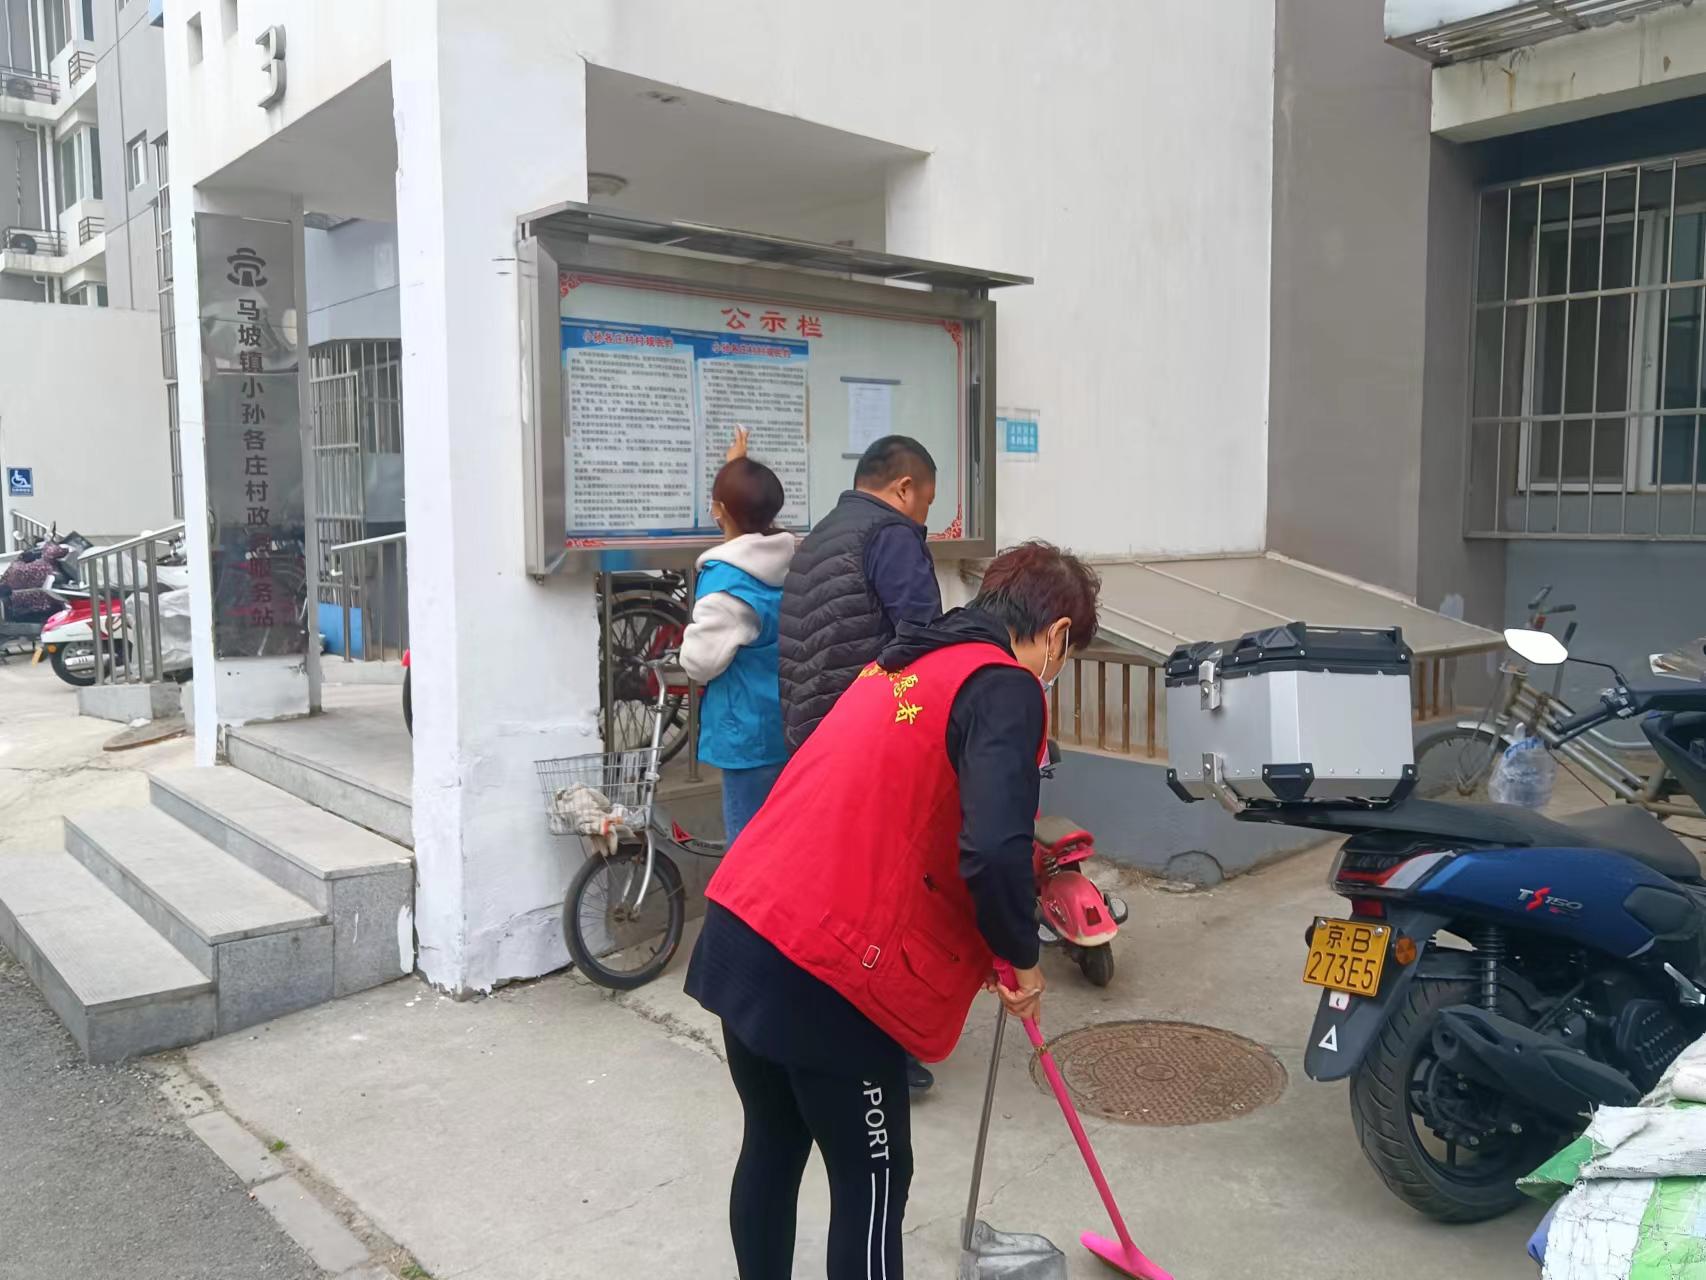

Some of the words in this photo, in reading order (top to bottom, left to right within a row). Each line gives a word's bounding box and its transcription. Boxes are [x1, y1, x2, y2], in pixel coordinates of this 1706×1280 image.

[255, 24, 288, 111] 3
[721, 307, 824, 339] 公示栏
[1307, 950, 1376, 990] 273E5
[862, 1080, 891, 1161] PORT
